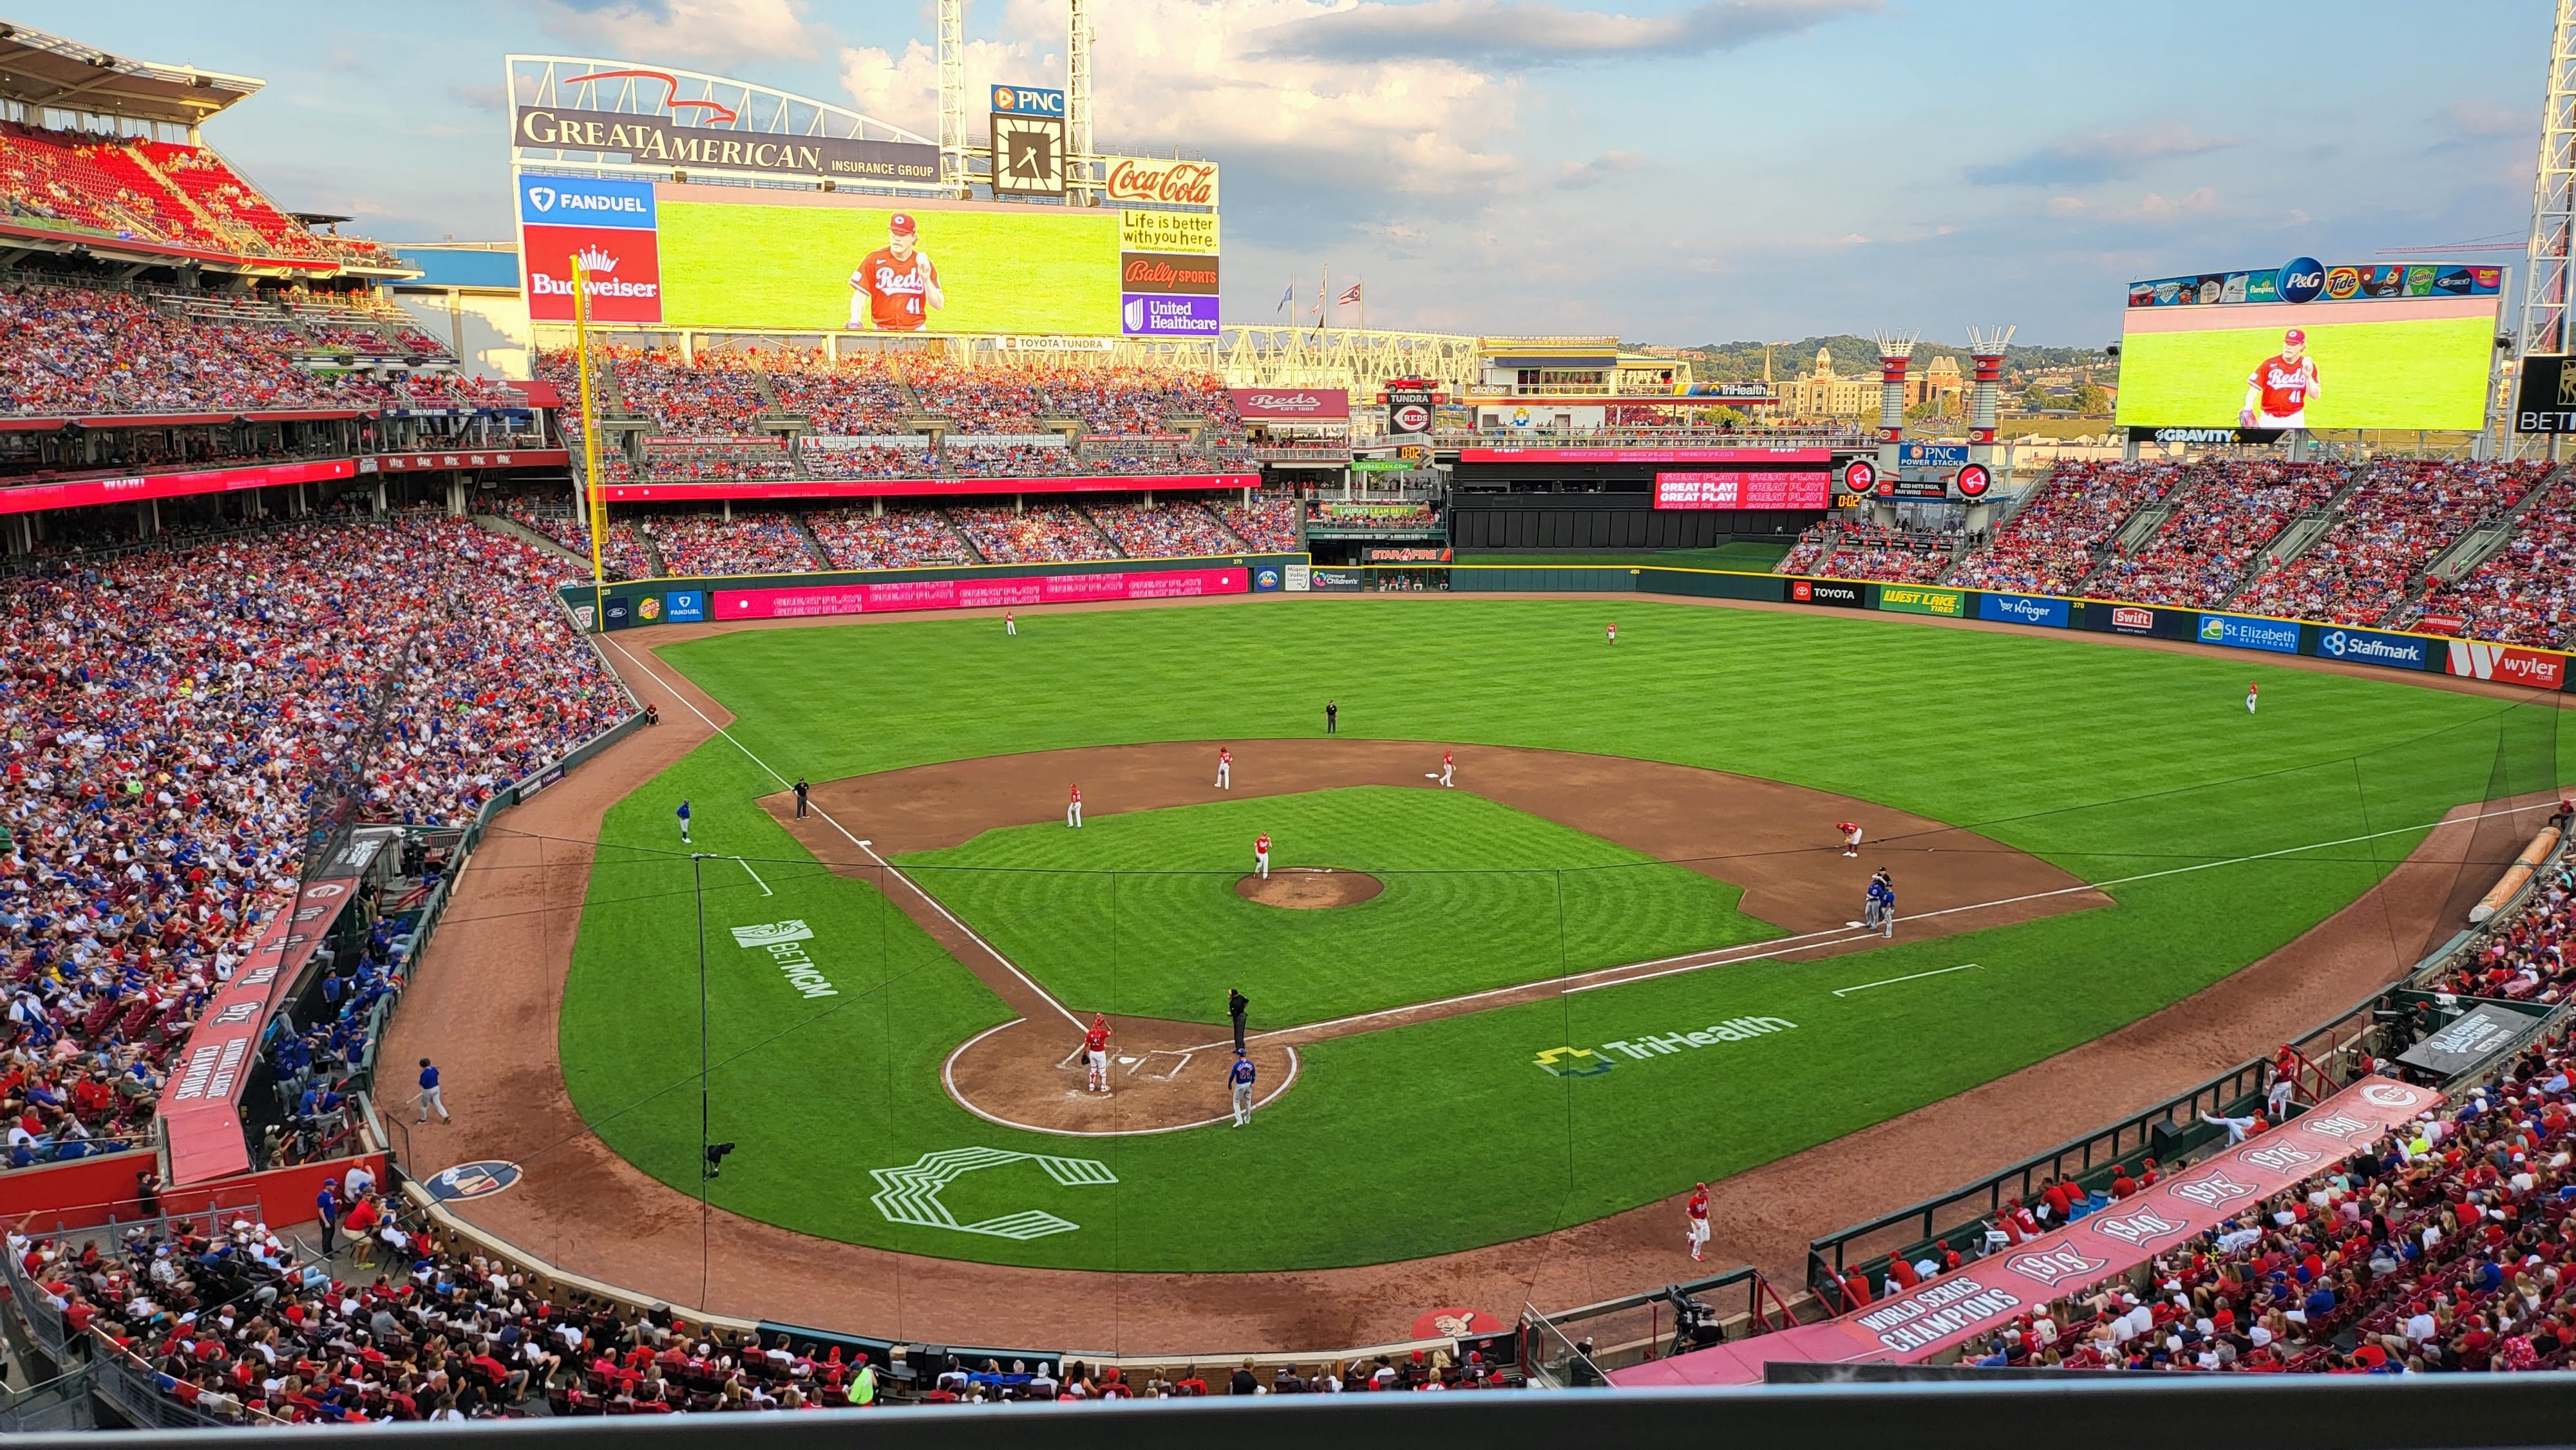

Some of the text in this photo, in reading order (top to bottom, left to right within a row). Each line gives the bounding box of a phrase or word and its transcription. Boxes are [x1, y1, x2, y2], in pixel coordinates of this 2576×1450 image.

[1018, 91, 1063, 112] PNC
[831, 160, 895, 175] INSURANCE
[898, 164, 934, 177] GROUP
[1108, 160, 1217, 203] Coca-Cola
[561, 194, 647, 212] FANDUEL
[1125, 211, 1213, 231] Life is better
[1124, 230, 1217, 247] with you here.
[875, 267, 923, 296] Reds
[1126, 260, 1217, 288] Bally SPORTS
[2286, 272, 2322, 288] P&G
[2407, 272, 2433, 285] Bounty
[2249, 283, 2275, 295] Pampers
[2329, 276, 2356, 294] Tide
[906, 297, 920, 315] 41
[1150, 301, 1192, 315] United
[1150, 315, 1217, 330] Healthcare
[1020, 339, 1103, 349] TOYOTA TUNDRA
[2266, 368, 2306, 390] Reds
[1391, 395, 1428, 403] TUNDRA
[1470, 385, 1507, 395] altafiber
[1721, 384, 1766, 396] TriHealth
[2289, 390, 2301, 403] 41
[1248, 393, 1321, 409] Reds
[2521, 412, 2576, 430] BET
[1402, 446, 1421, 458] 0:02
[1925, 447, 1956, 459] PNC
[1662, 473, 1703, 481] GREAT
[1748, 473, 1790, 481] GREAT
[1660, 482, 1738, 492] GREAT PLAY!
[1747, 482, 1824, 492] GREAT PLAY!
[1660, 493, 1737, 502] GREAT PLAY!
[1747, 493, 1823, 502] GREAT PLAY!
[1839, 495, 1860, 507] 0:02
[1372, 550, 1437, 560] STAR FIRE
[1814, 588, 1855, 600] TOYOTA
[1883, 588, 1958, 608] WEST LAKE
[639, 599, 659, 614] Kahn's
[2014, 599, 2050, 621] Kroger
[580, 613, 590, 621] 32
[2117, 612, 2148, 625] Swift
[2224, 624, 2296, 643] St. Elizabeth
[2240, 637, 2294, 648] HEALTHCARE
[2349, 638, 2420, 661] Staffmark
[2504, 657, 2558, 677] wyler
[766, 942, 838, 999] BETMGM
[218, 1002, 259, 1023] 1972
[2452, 1013, 2491, 1036] COUNTRY
[2468, 1022, 2498, 1040] CARES
[1602, 1015, 1798, 1059] TriHealth
[2430, 1034, 2469, 1053] Reds
[175, 1045, 221, 1100] CHAMPIONS
[206, 1037, 249, 1099] NATIONAL LEAGUE
[2379, 1086, 2406, 1102] REDS
[2311, 1116, 2367, 1138] 1990
[2248, 1146, 2305, 1171] 1976
[2179, 1179, 2246, 1205] 1975
[2103, 1213, 2172, 1243] 1940
[2015, 1251, 2090, 1280] 1919
[1857, 1276, 1983, 1332] WORLD SERIES
[1879, 1288, 2021, 1352] CHAMPIONS
